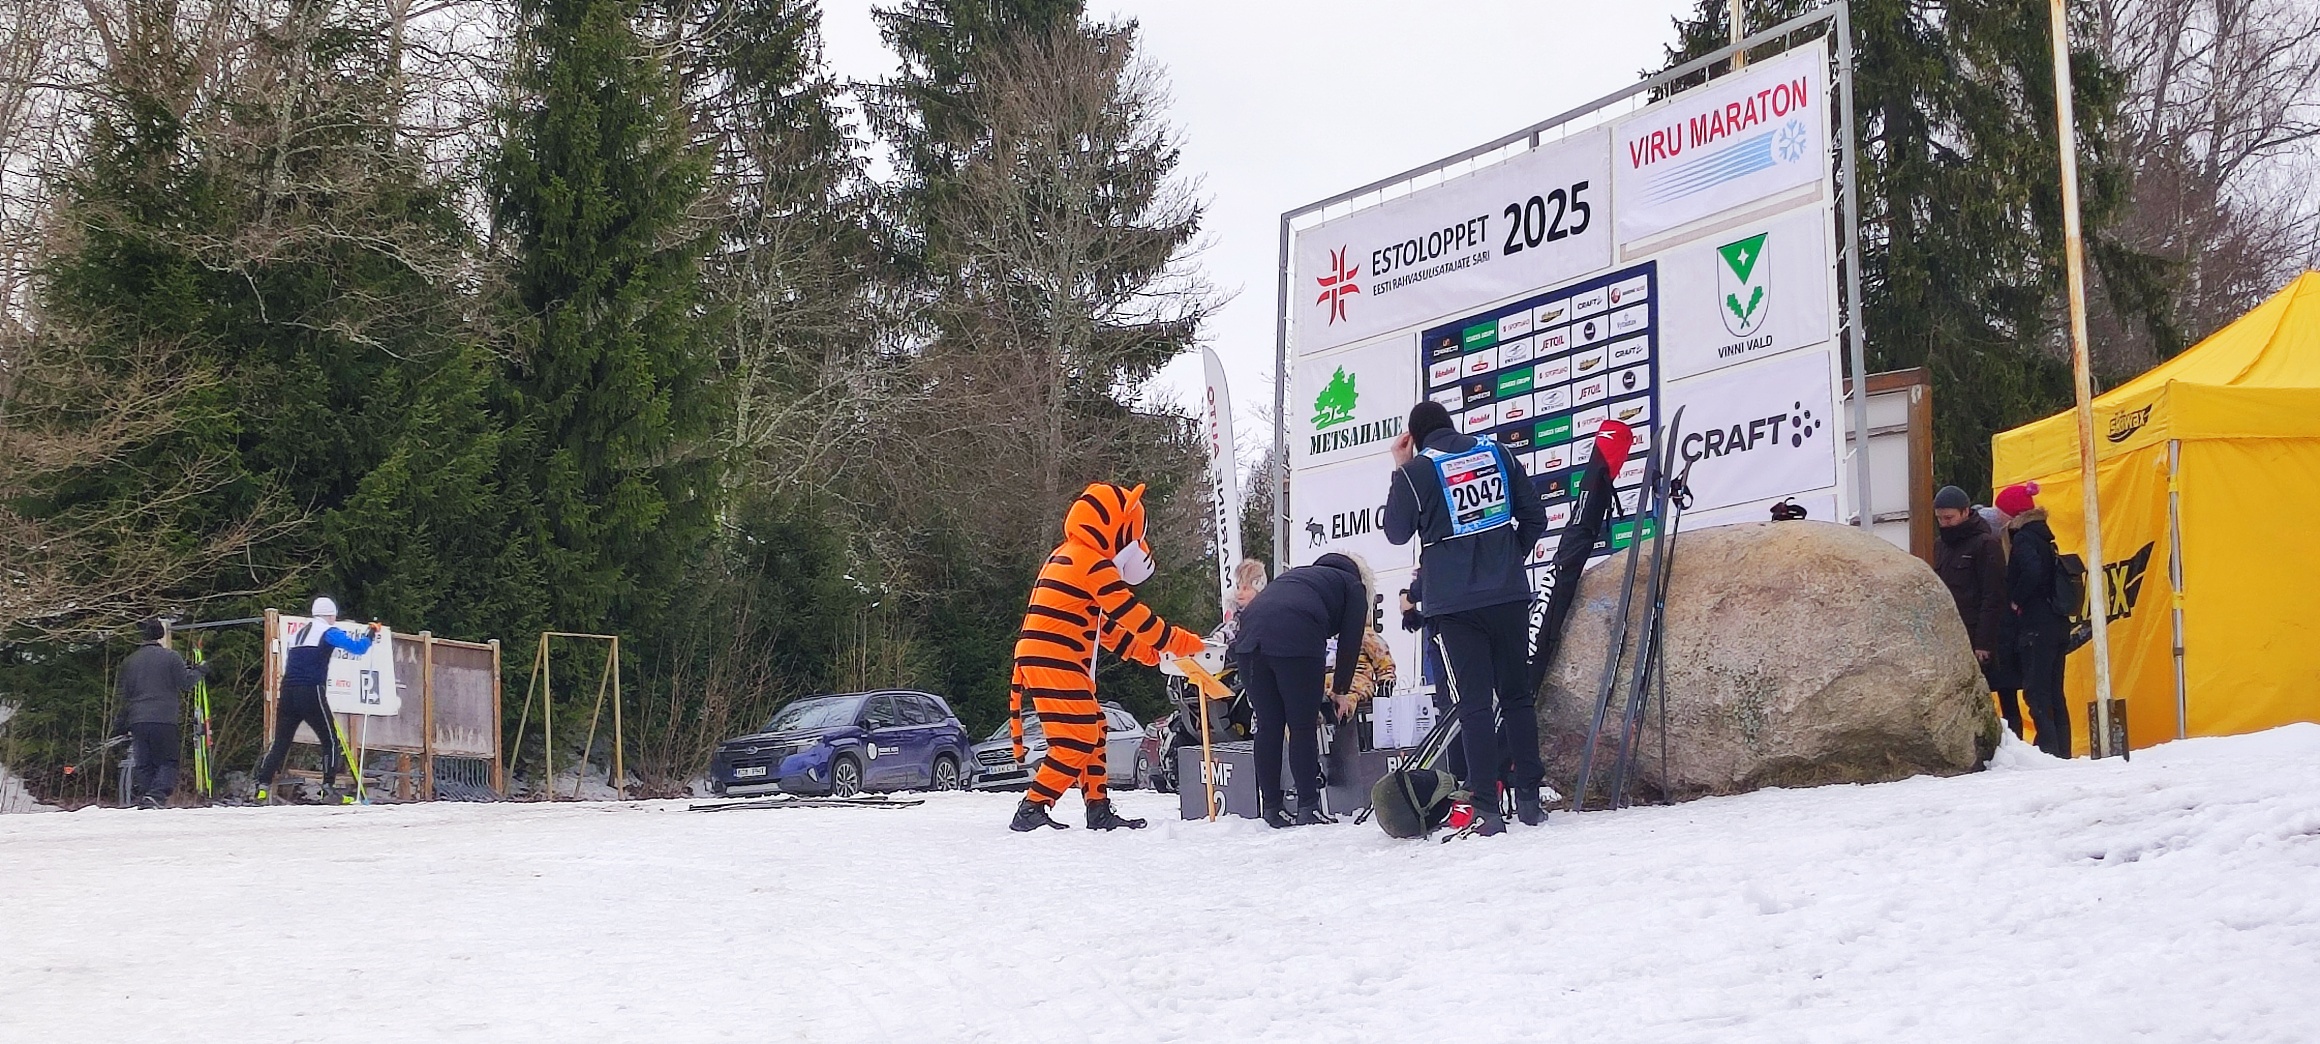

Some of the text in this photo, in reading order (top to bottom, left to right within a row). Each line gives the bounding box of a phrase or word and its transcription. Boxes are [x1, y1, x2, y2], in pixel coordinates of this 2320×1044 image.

[1629, 76, 1808, 169] VIRU MARATON
[1372, 181, 1591, 277] ESTOLOPPET 2025
[1373, 283, 1392, 297] EESTI
[1472, 250, 1490, 269] SARI
[1717, 335, 1773, 359] VINNI VALD
[1309, 416, 1403, 456] METSAHAKE
[1681, 413, 1787, 463] CRAFT
[1452, 477, 1505, 512] 2042
[1331, 508, 1371, 539] ELMI
